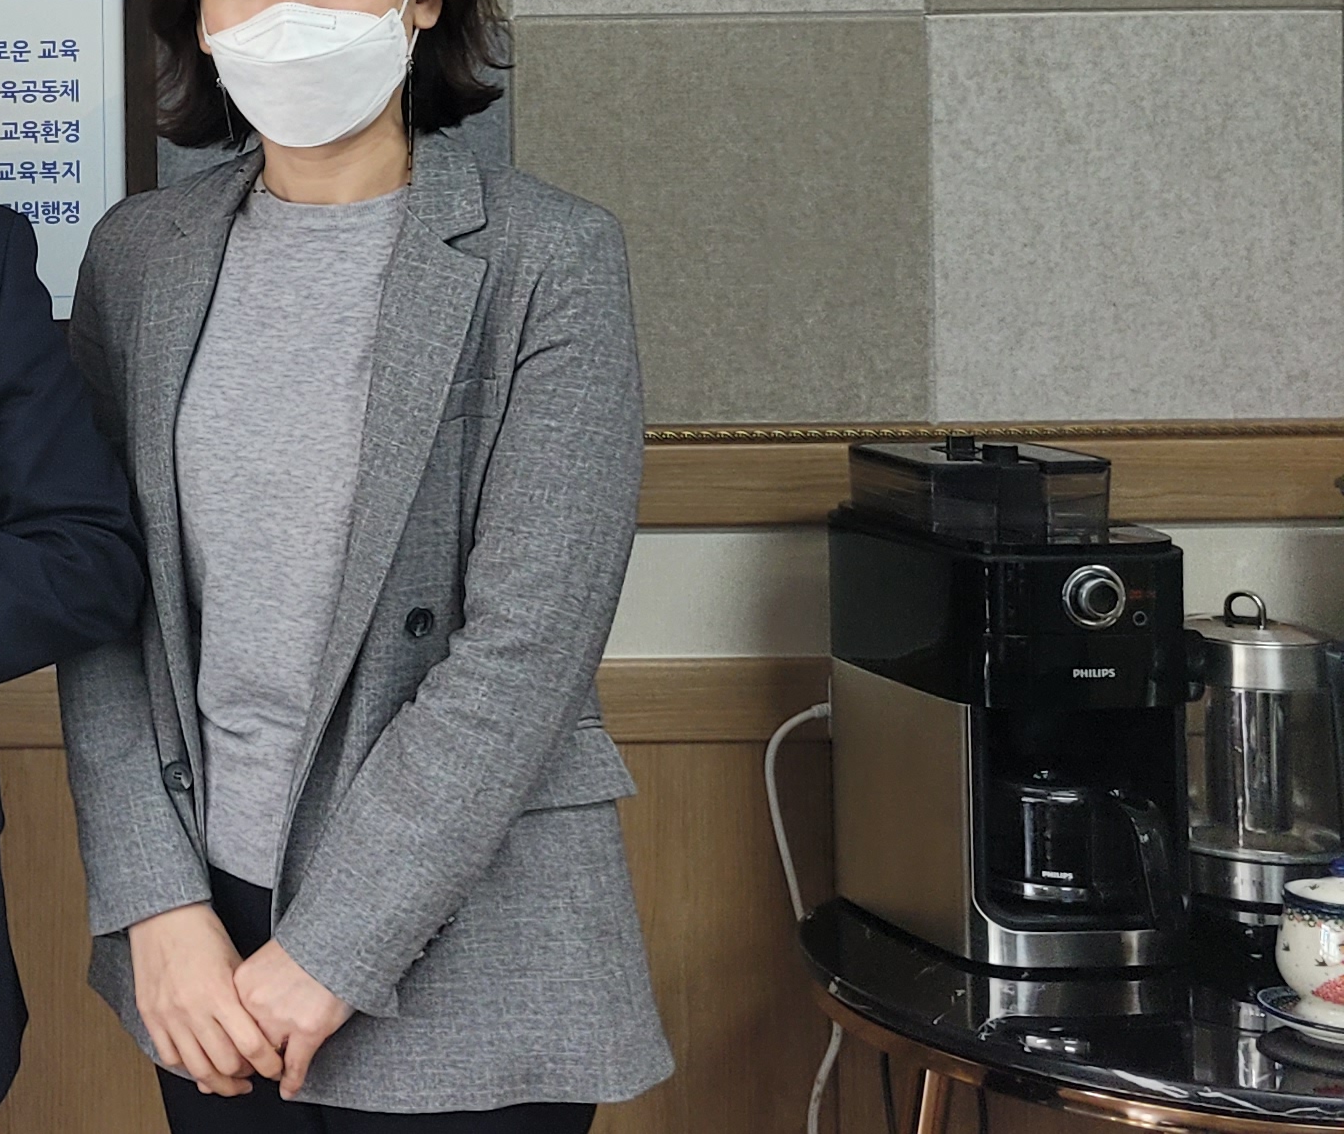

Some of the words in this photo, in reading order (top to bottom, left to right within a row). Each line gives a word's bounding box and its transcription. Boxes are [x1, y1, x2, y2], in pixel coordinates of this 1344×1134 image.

[37, 39, 80, 62] 교육
[0, 120, 80, 144] 교육환경
[1072, 668, 1116, 678] PHILIPS
